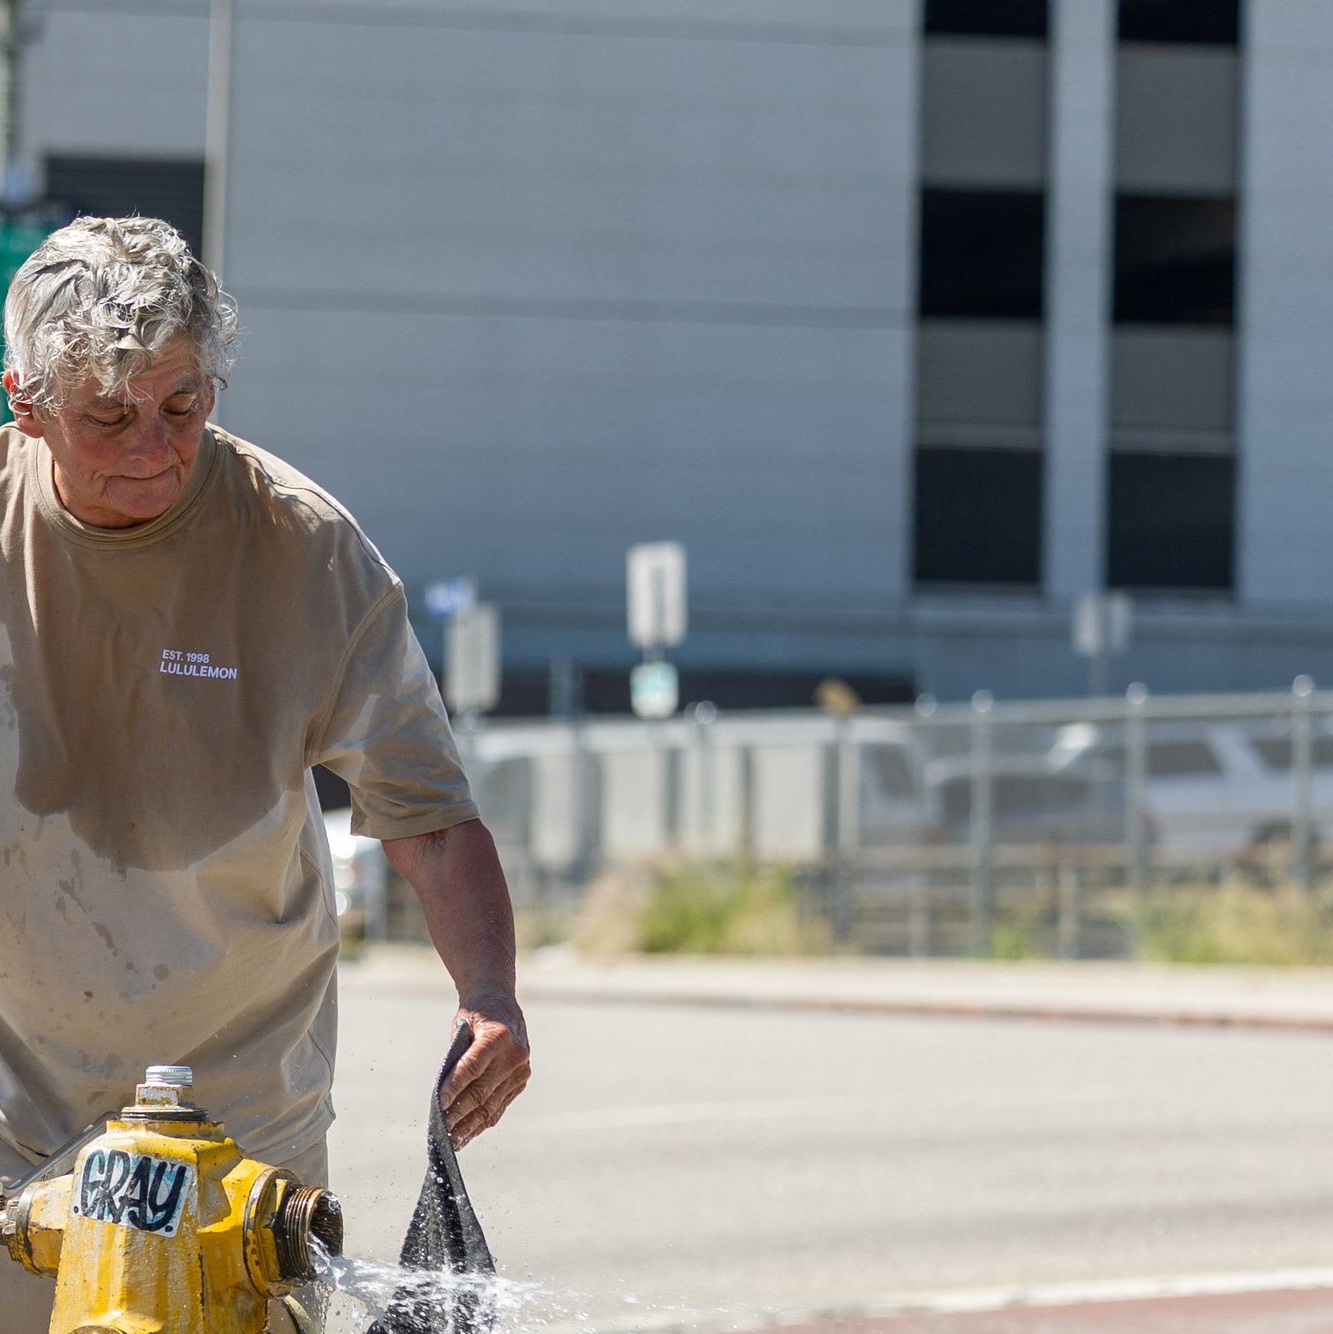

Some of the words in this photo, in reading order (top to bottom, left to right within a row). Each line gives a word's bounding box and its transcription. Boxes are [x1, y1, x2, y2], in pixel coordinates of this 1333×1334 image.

[162, 649, 184, 662] EST.
[186, 652, 210, 664] 1998
[159, 661, 238, 680] LULULEMON
